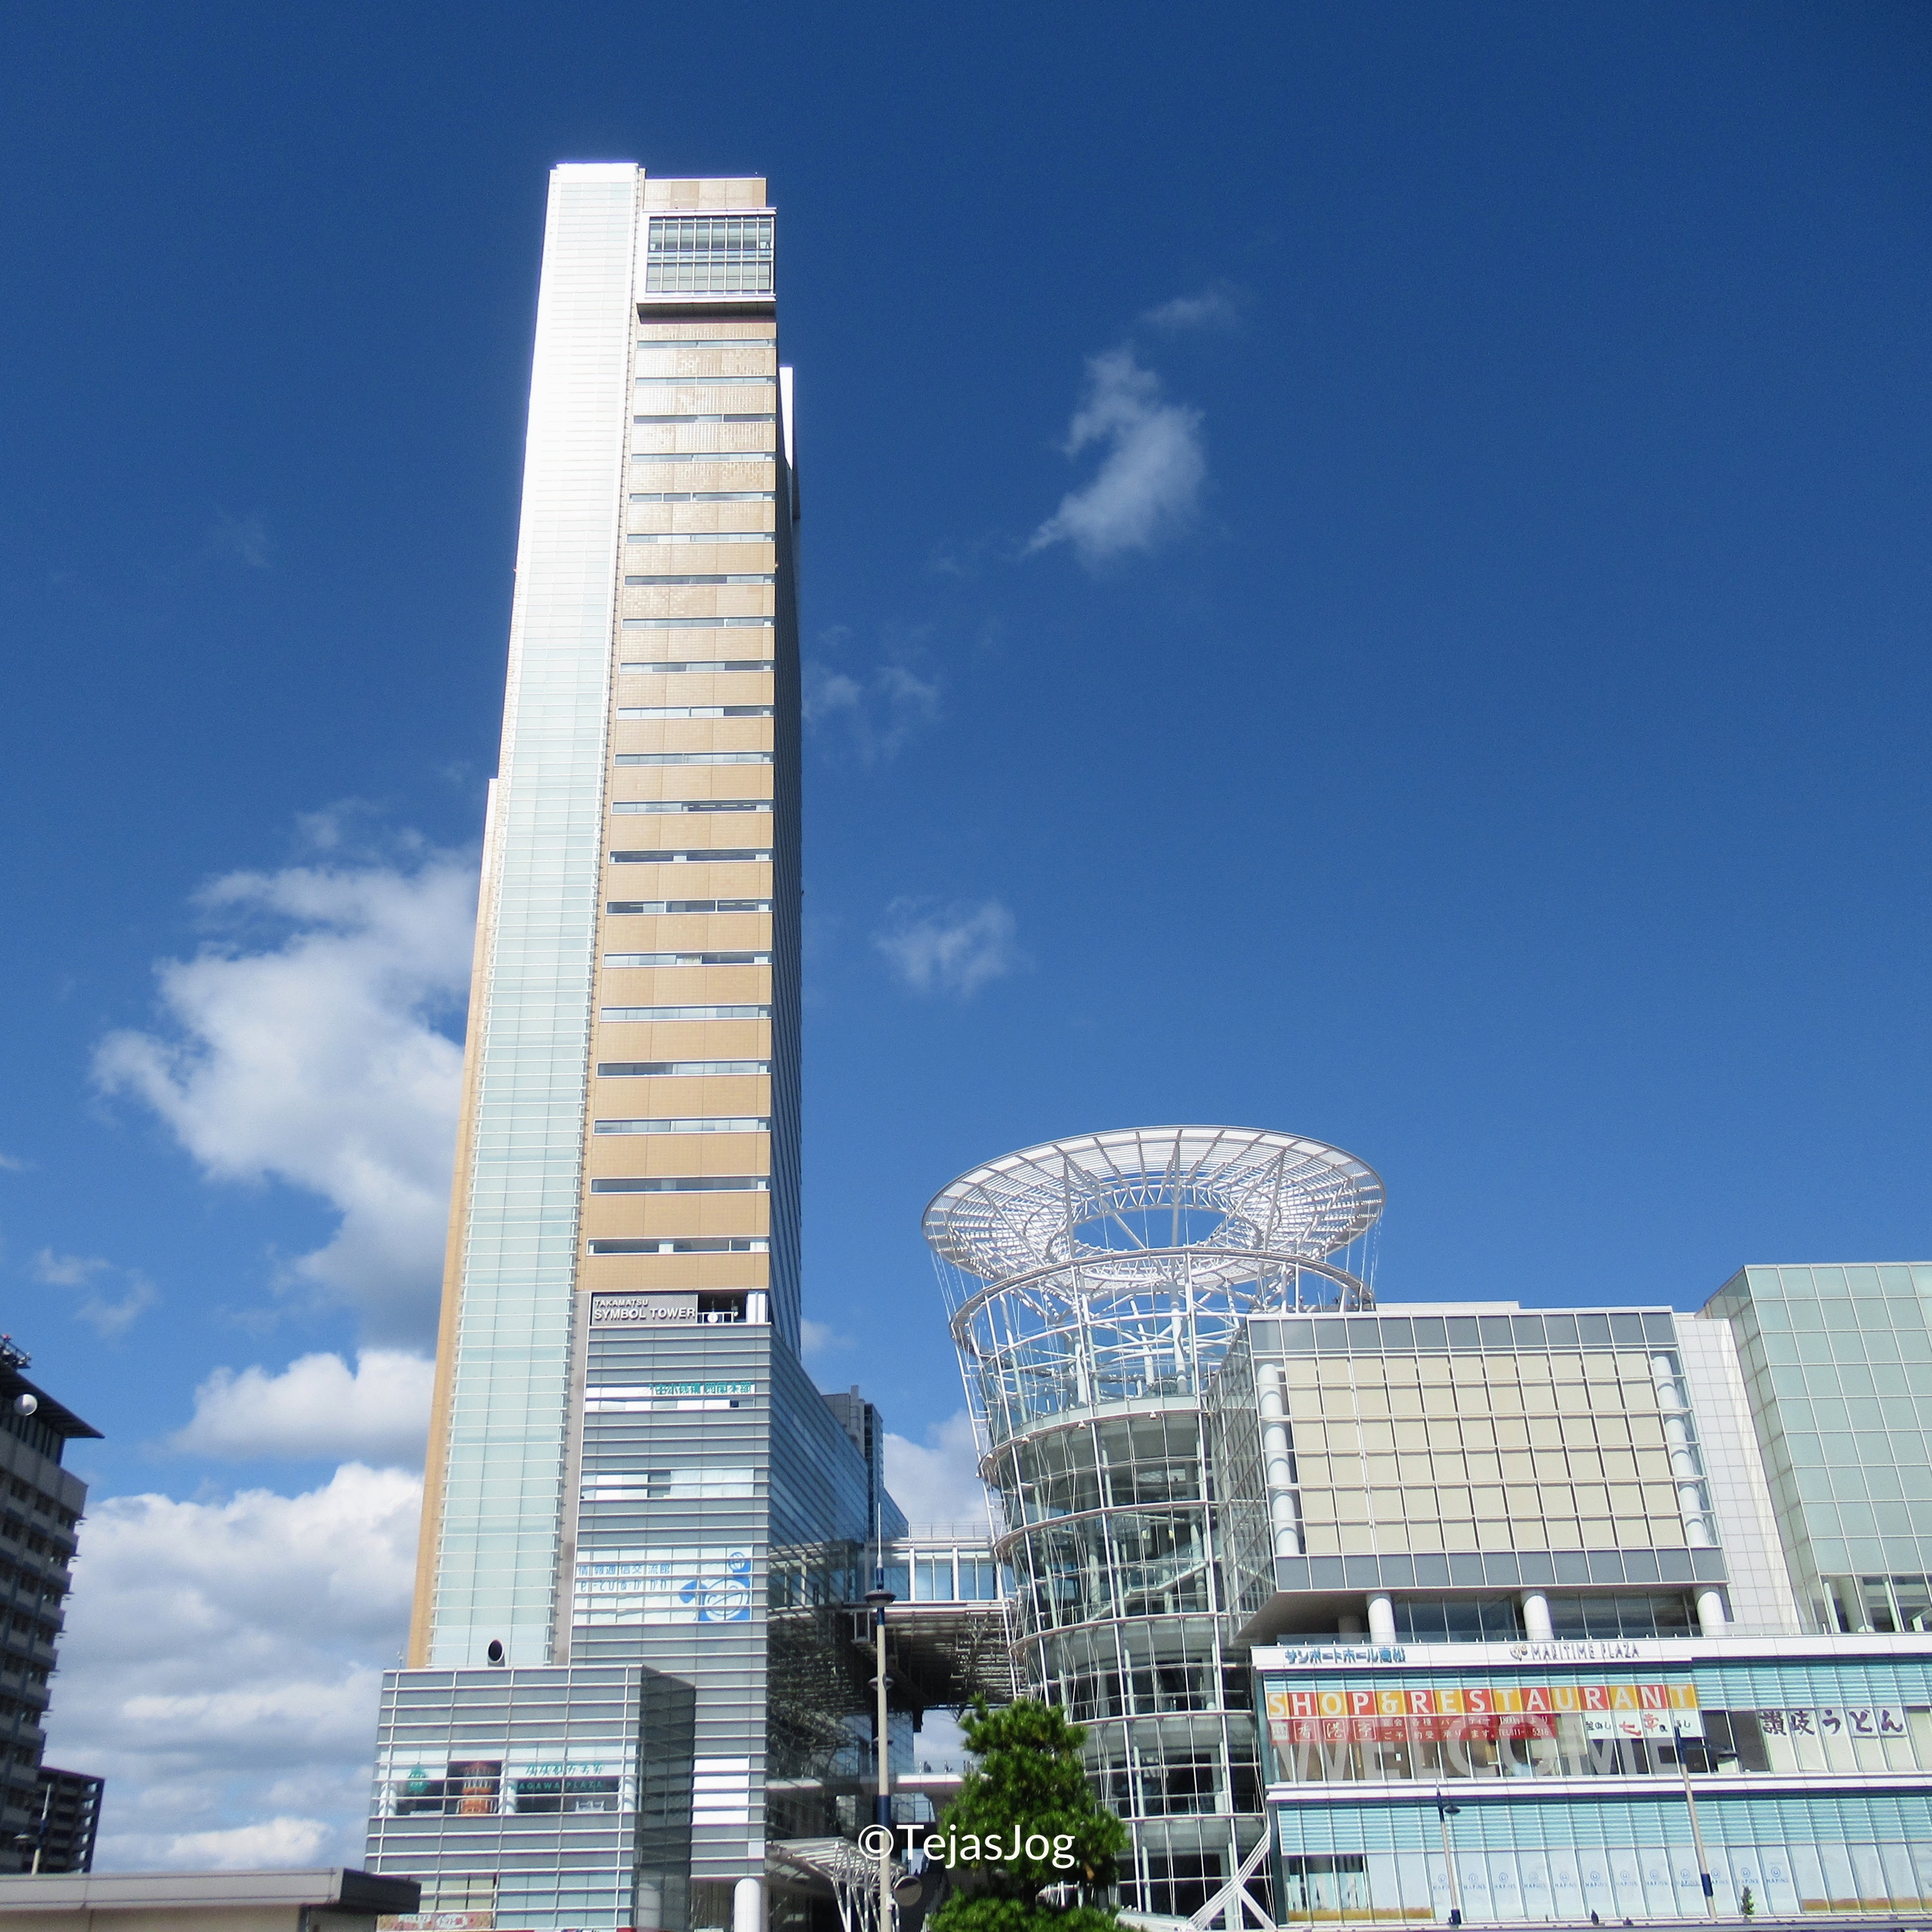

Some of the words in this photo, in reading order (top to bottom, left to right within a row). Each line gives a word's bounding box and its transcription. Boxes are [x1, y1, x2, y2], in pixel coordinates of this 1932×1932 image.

[595, 1299, 648, 1307] TAKAMATSU
[594, 1308, 647, 1320] SYMBOL
[651, 1307, 695, 1319] TOWER
[1284, 1646, 1406, 1664] サンポートホール高松
[1531, 1642, 1595, 1660] MARITIME
[1601, 1641, 1640, 1660] PLAZA
